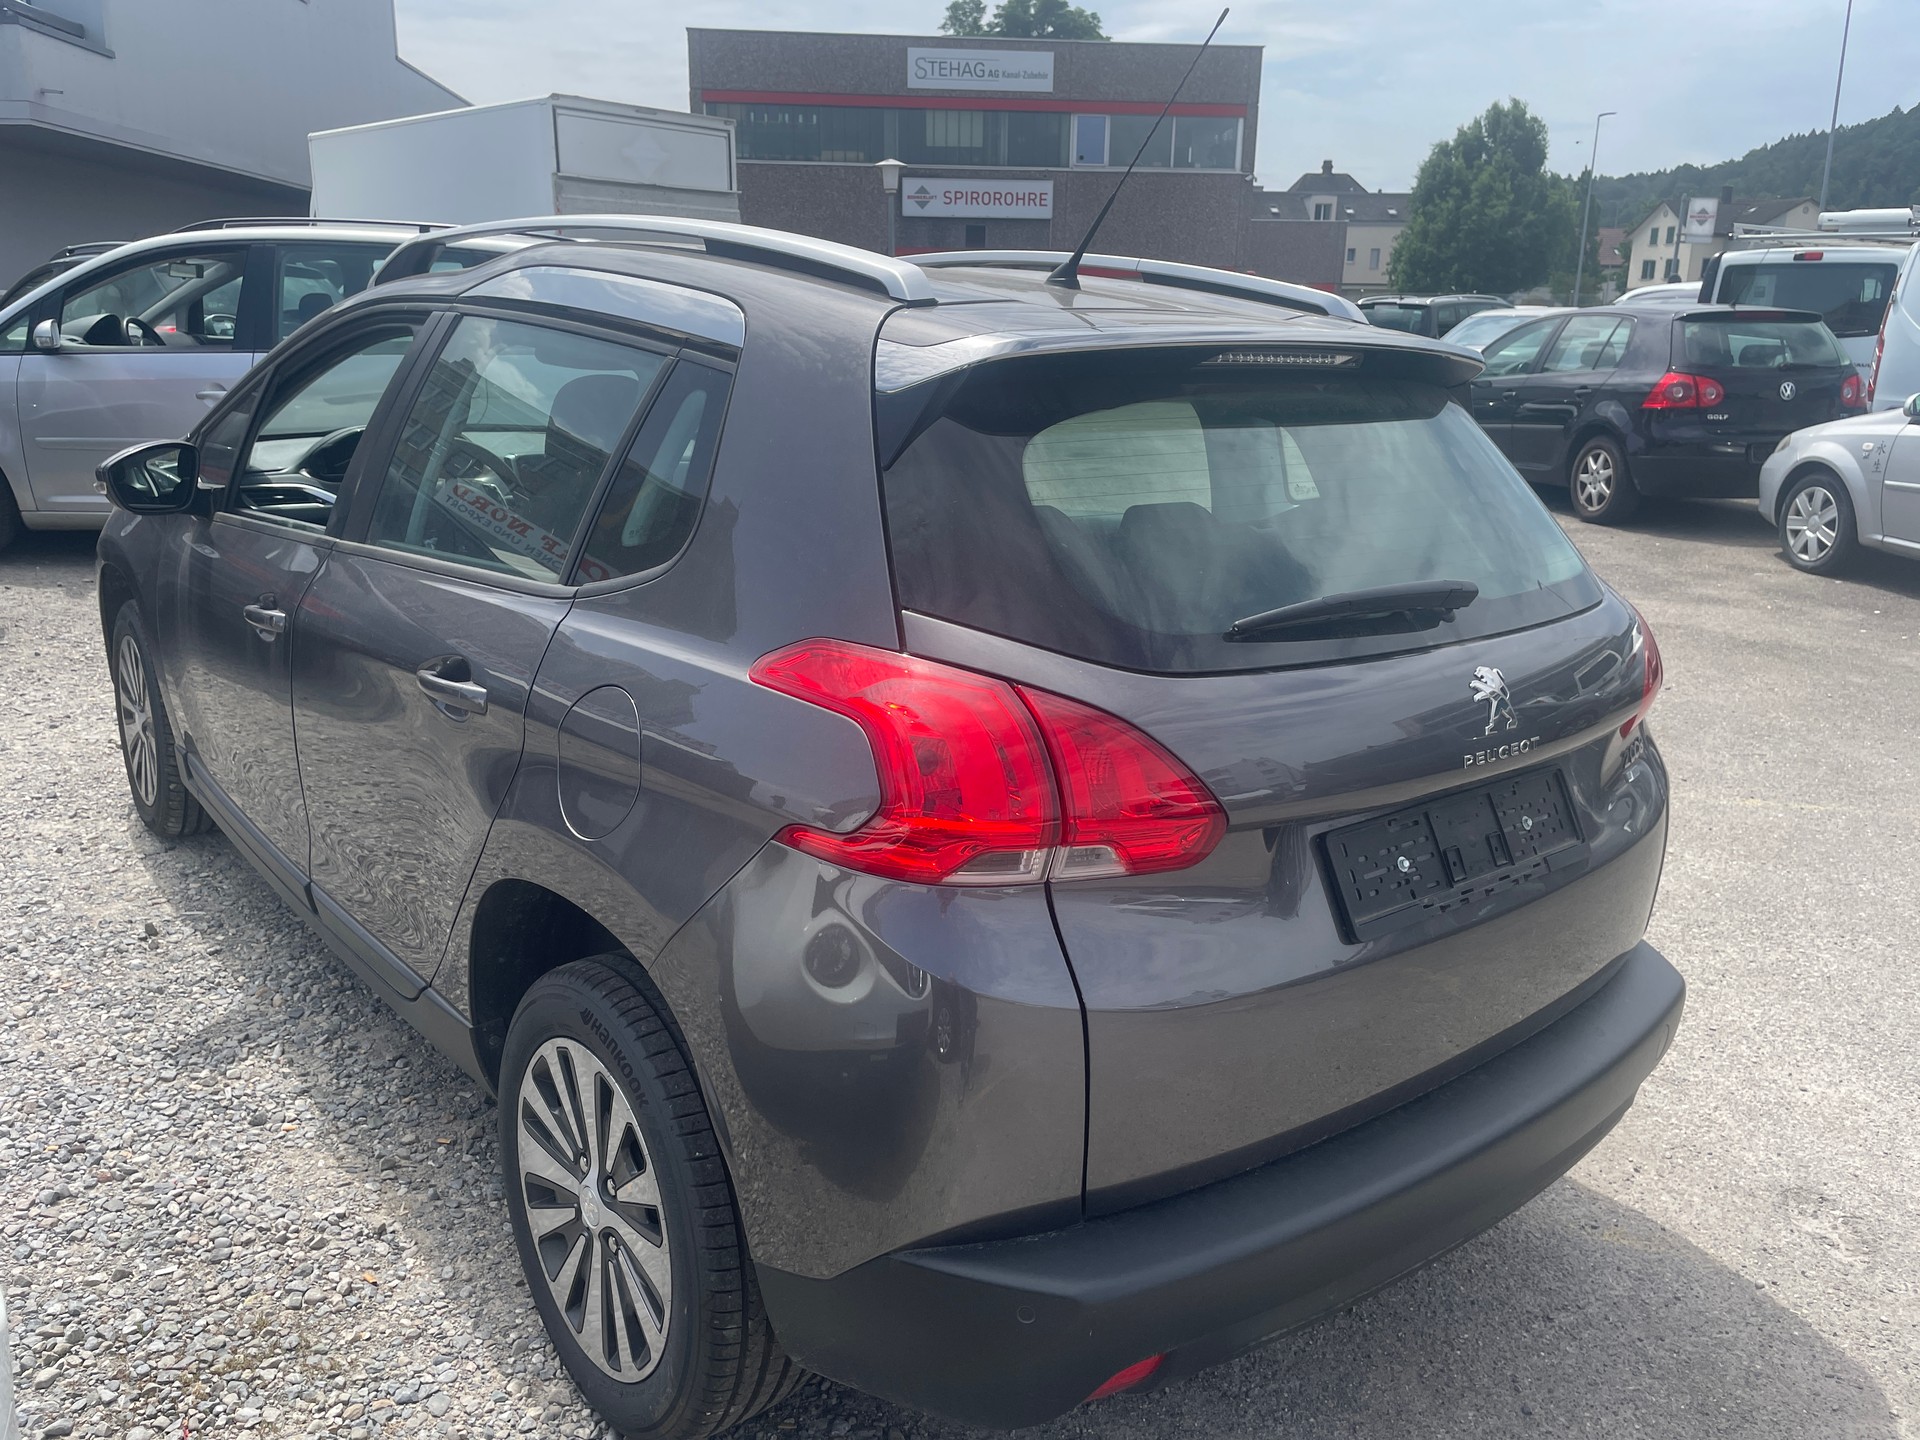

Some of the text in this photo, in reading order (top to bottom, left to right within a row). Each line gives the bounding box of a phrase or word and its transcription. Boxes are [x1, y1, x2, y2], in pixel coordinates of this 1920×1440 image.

[914, 57, 985, 79] STEHAG
[987, 69, 1000, 78] AG
[943, 190, 1048, 207] SPIROROHRE
[1707, 413, 1729, 421] GOLF
[1463, 735, 1540, 769] PEUGEOT
